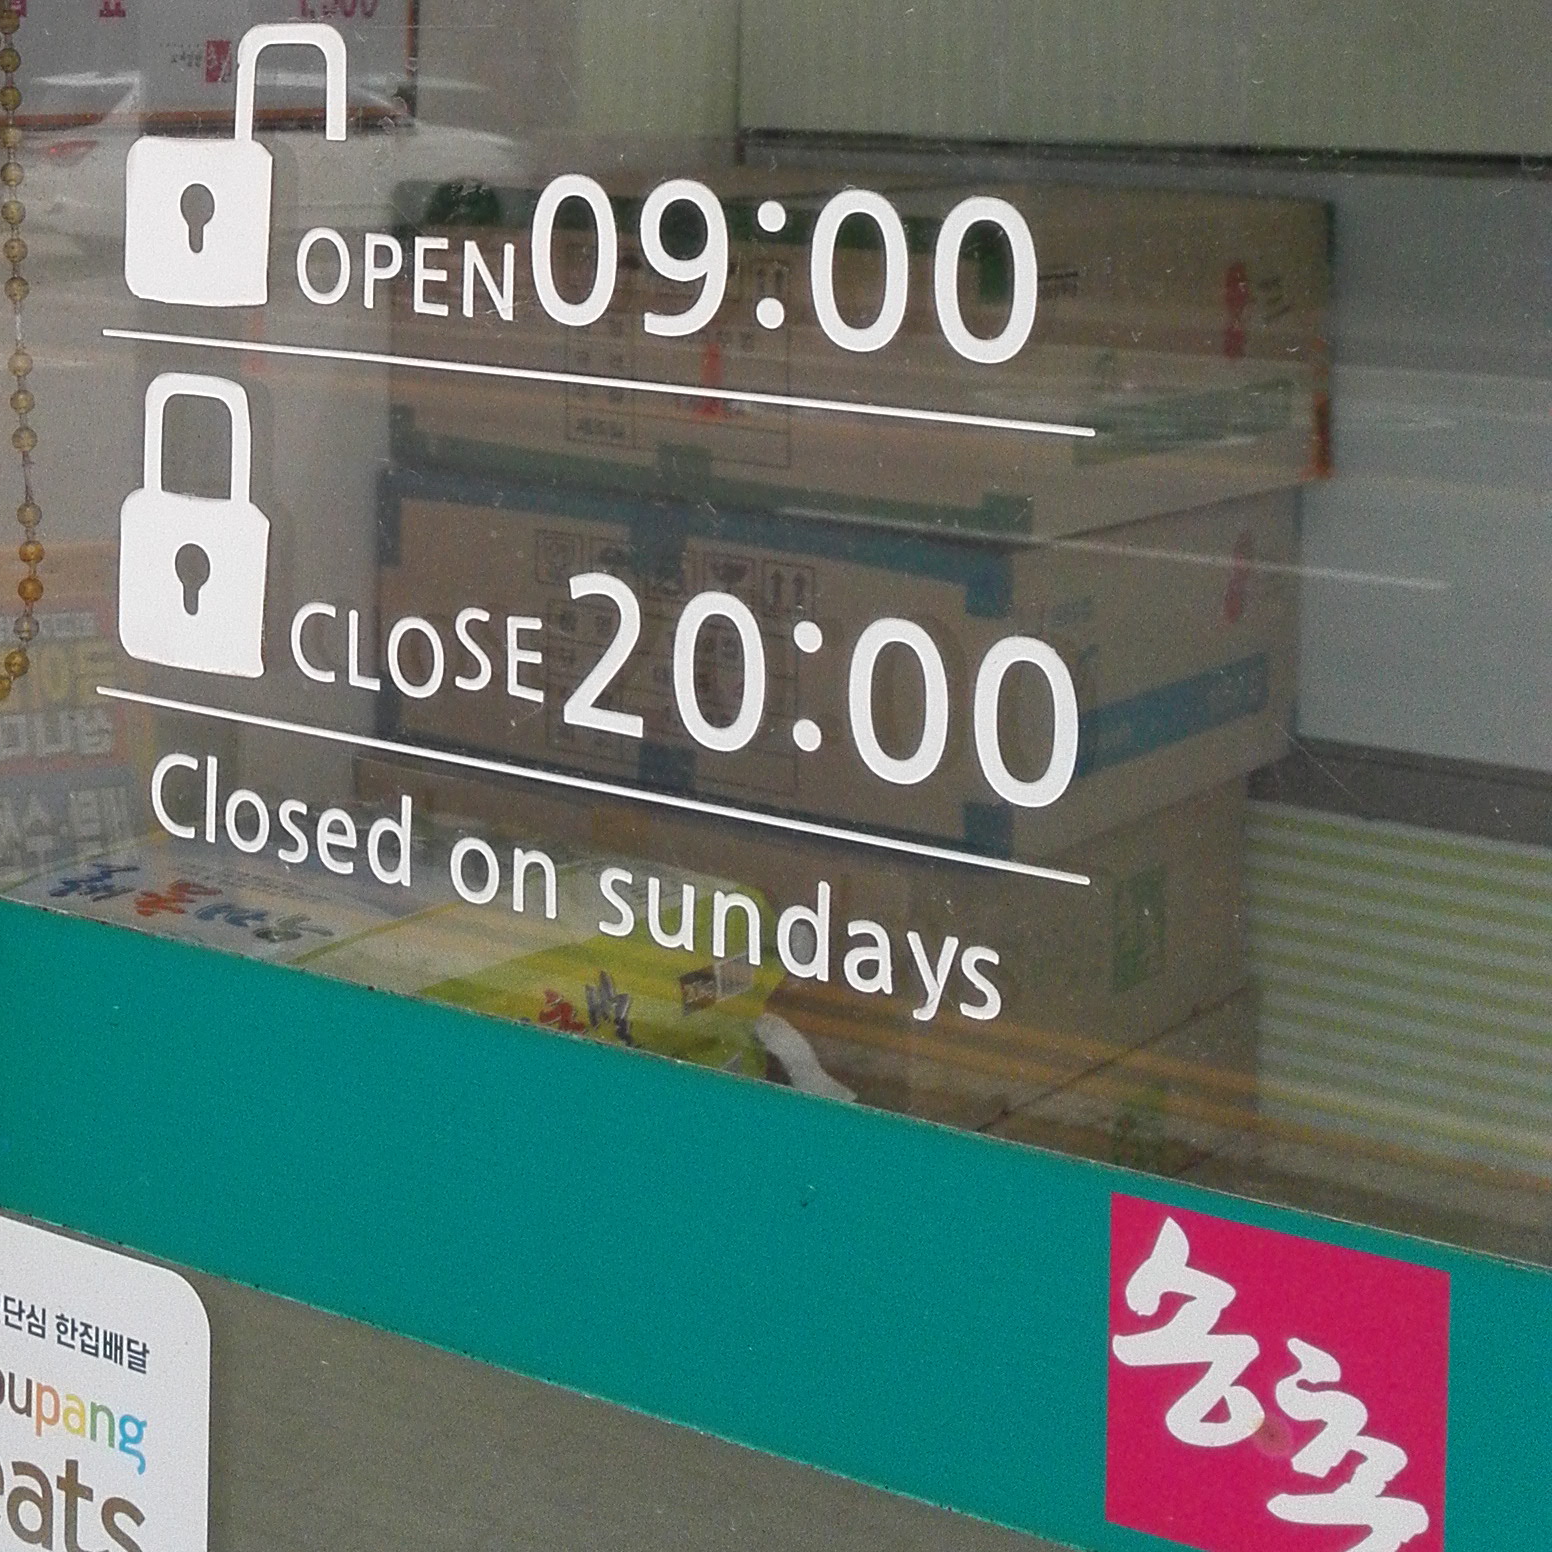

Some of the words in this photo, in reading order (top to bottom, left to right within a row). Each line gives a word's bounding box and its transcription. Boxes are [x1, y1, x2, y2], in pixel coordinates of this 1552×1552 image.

[296, 225, 516, 323] OPEN
[530, 172, 1038, 365] 09:00
[289, 600, 545, 704] CLOSE
[562, 571, 1080, 809] 20:00
[150, 752, 413, 888] Closed
[449, 835, 559, 921] on
[597, 866, 1004, 1023] sundays
[54, 1312, 151, 1375] 한집배달
